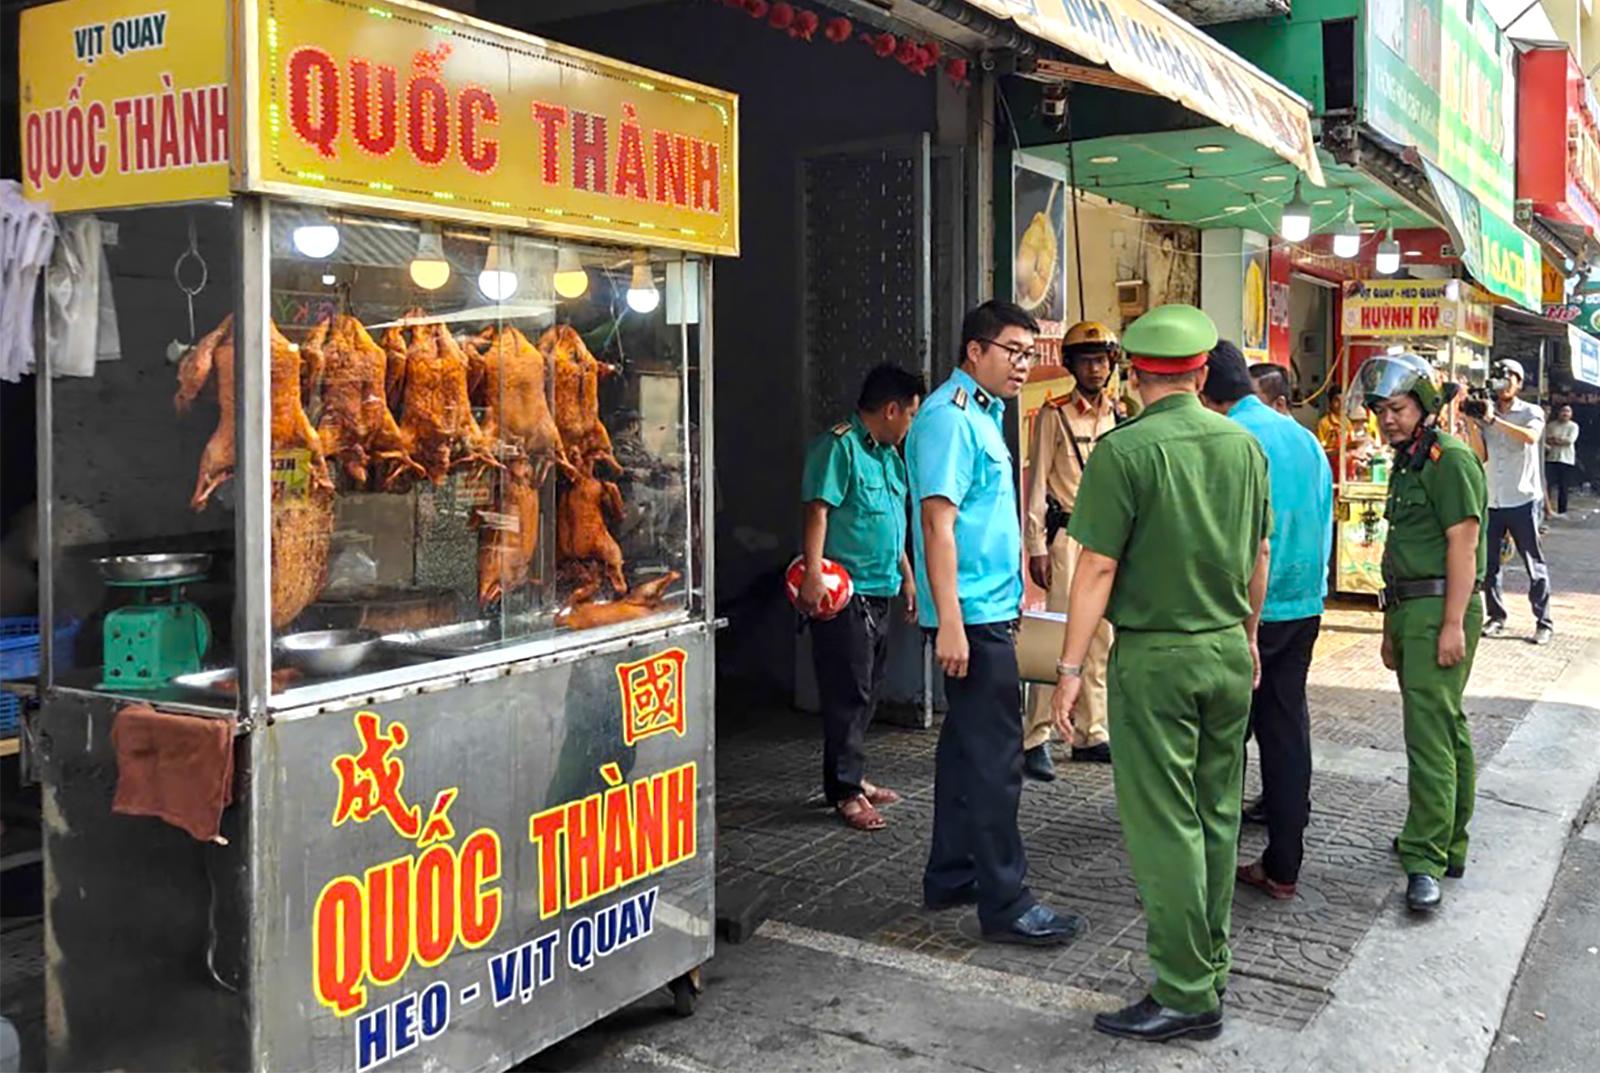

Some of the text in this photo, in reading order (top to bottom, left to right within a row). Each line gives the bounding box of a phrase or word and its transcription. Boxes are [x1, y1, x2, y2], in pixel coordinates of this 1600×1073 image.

[74, 13, 167, 65] VỊT QUAY
[25, 72, 229, 191] QUỐC THÀNH
[285, 42, 722, 214] QUỐC THÀNH
[1361, 301, 1413, 330] HUỲNH
[1373, 287, 1395, 299] QUAY
[616, 648, 688, 746] 國
[332, 711, 421, 837] 成
[312, 761, 697, 1017] QUỐC THÀNH
[356, 981, 450, 1073] HEO
[488, 930, 561, 1007] VỊT
[567, 887, 659, 970] QUAY
